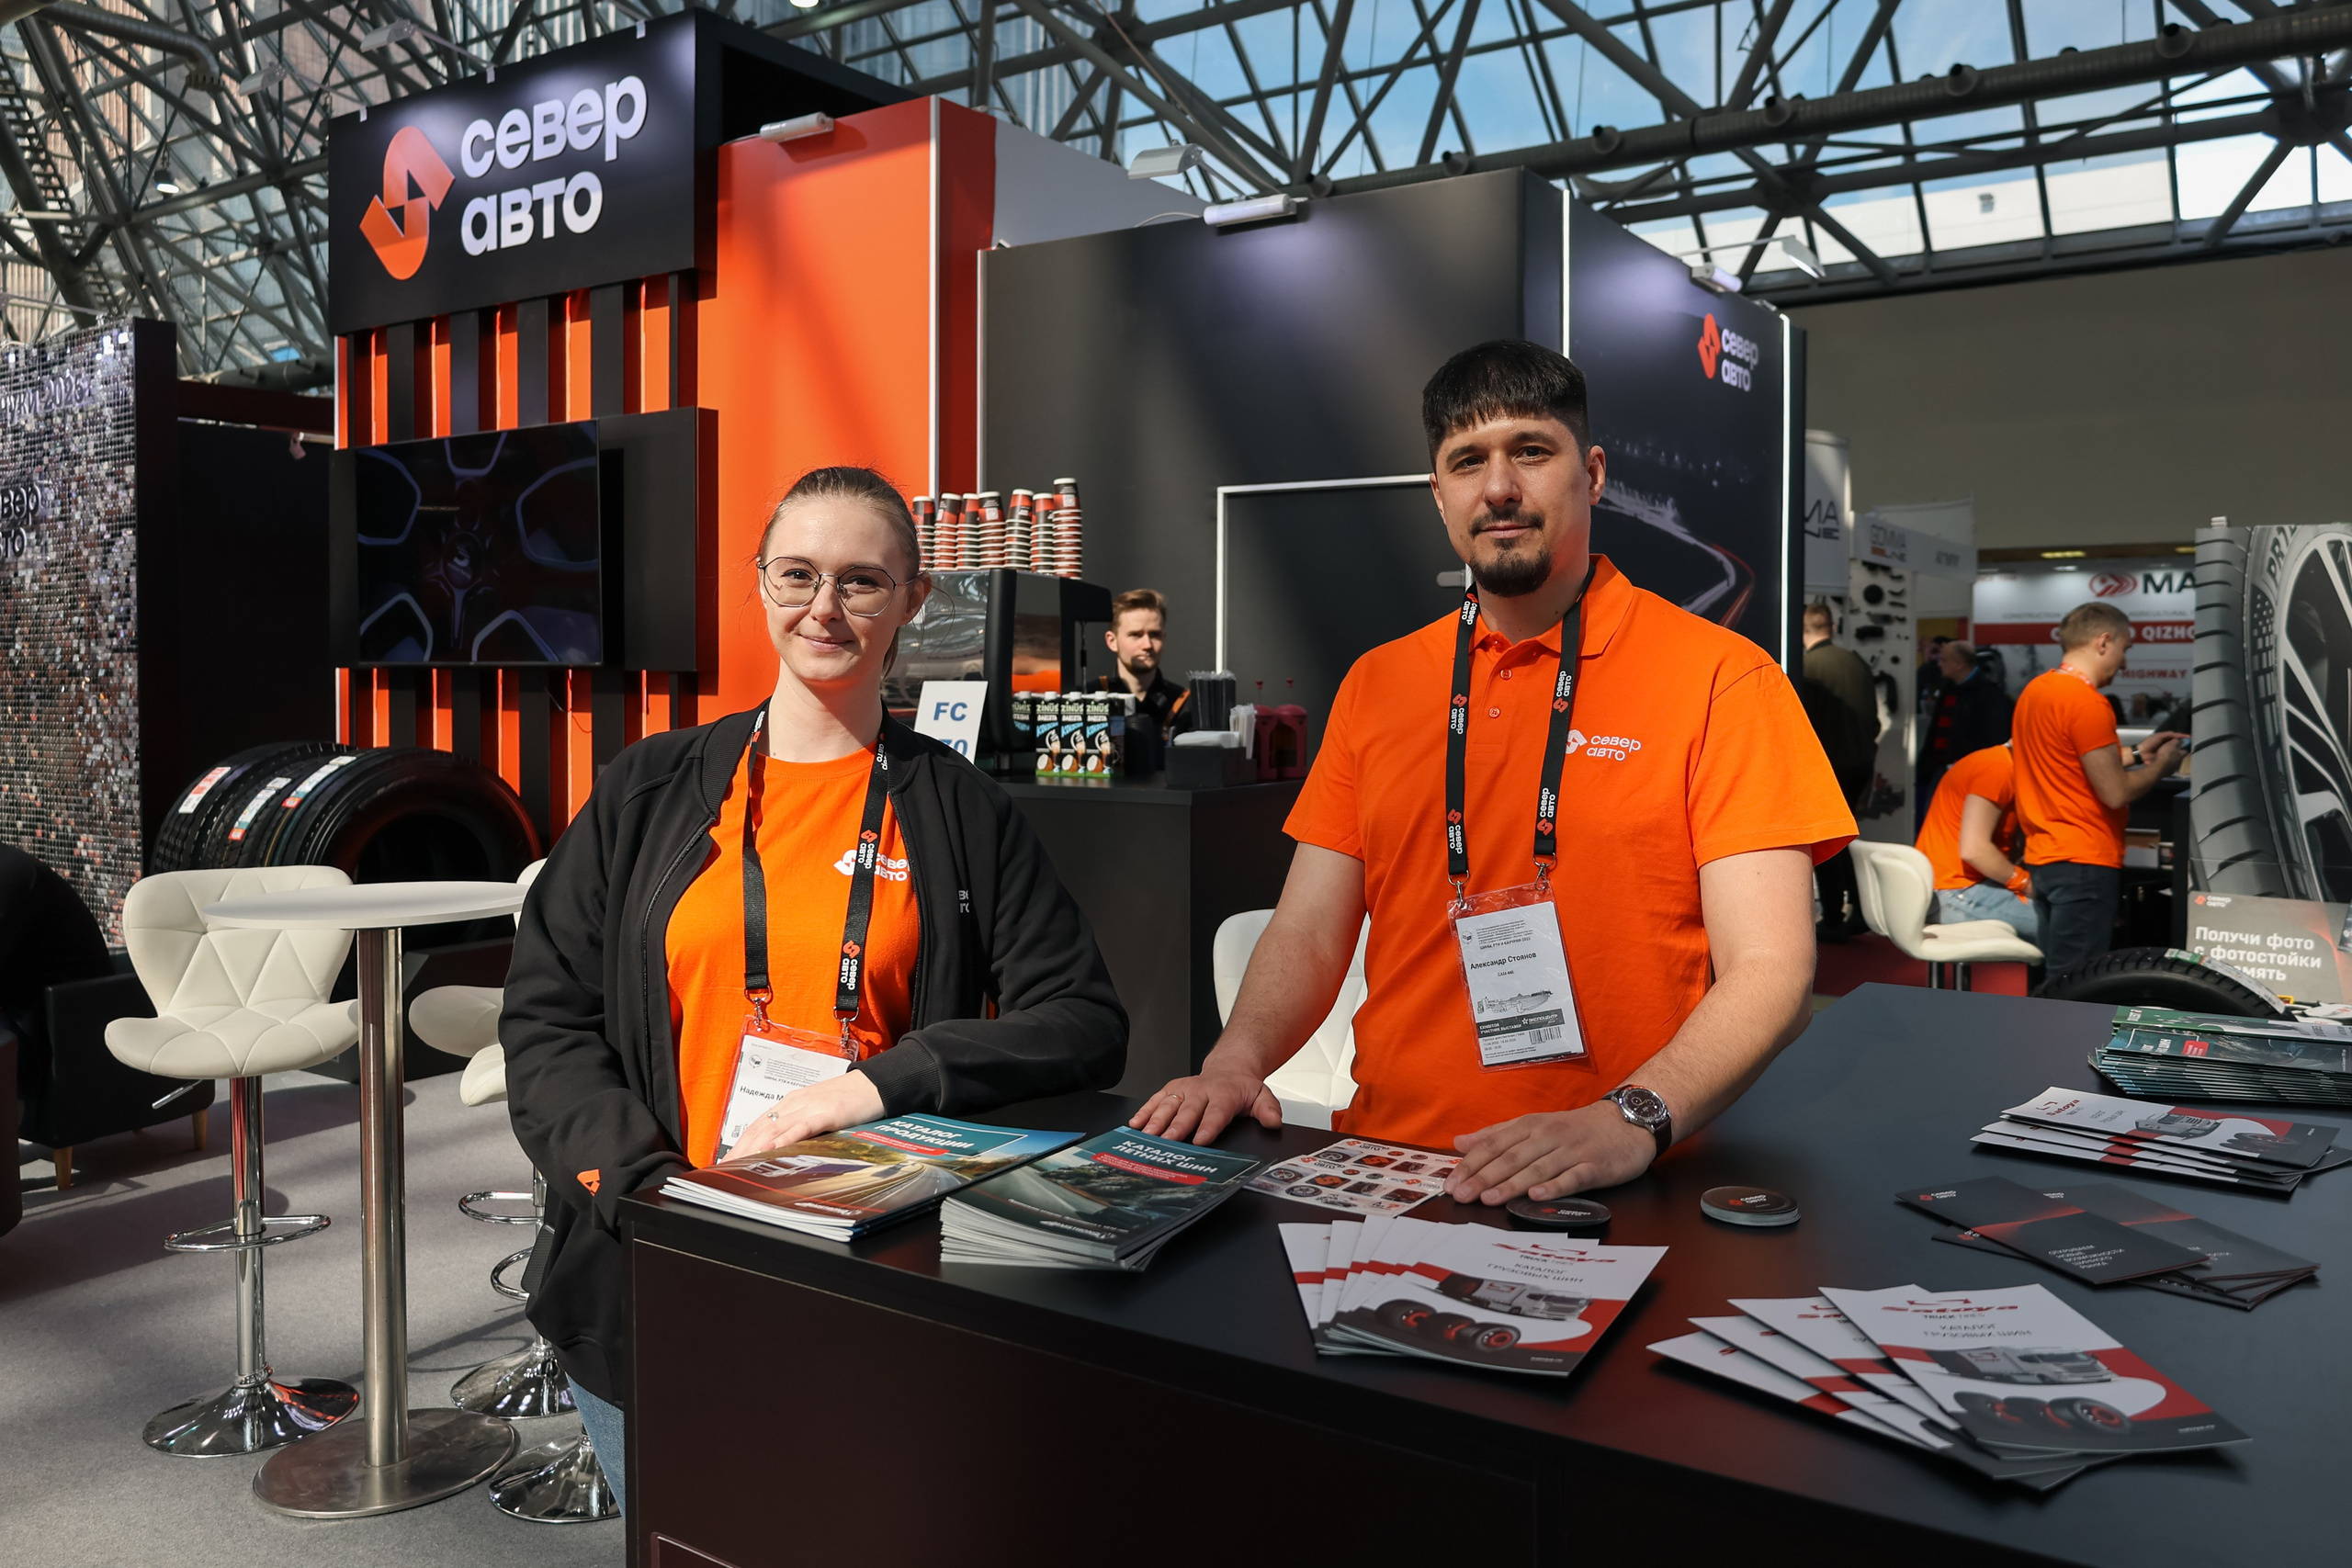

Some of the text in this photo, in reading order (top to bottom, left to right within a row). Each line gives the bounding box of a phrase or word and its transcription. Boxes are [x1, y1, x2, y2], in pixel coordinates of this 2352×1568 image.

[460, 75, 647, 178] север
[460, 171, 603, 256] авто
[1721, 328, 1759, 370] север
[1721, 358, 1752, 392] авто
[1461, 601, 1471, 621] авто
[1465, 603, 1477, 626] север
[1556, 671, 1566, 697] север
[1564, 675, 1572, 697] авто
[933, 702, 967, 721] FC
[1456, 707, 1464, 735] север
[1586, 746, 1625, 761] авто
[1590, 735, 1642, 752] север
[1539, 787, 1550, 818] север
[1547, 794, 1556, 818] авто
[1454, 825, 1463, 854] север
[857, 843, 867, 863] авто
[864, 843, 875, 869] север
[2207, 895, 2233, 903] север
[2195, 926, 2315, 951] Получи фото
[1470, 953, 1537, 970] Александр Стоянов
[2210, 944, 2322, 969] фотостойки
[840, 957, 850, 984] авто
[846, 958, 858, 991] север
[740, 1085, 775, 1100] Надежда
[2046, 1099, 2080, 1116] Satoya
[874, 1124, 975, 1149] ПРОДУКЦИИ
[889, 1121, 963, 1139] КАТАЛОГ
[1112, 1145, 1176, 1165] ЛЕТНИХ
[1176, 1161, 1218, 1173] ШИН
[1122, 1140, 1196, 1162] КАТАЛОГ
[1487, 1263, 1584, 1283] ГРУЗОВЫХ ШИН
[1514, 1263, 1567, 1275] КАТАЛОГ
